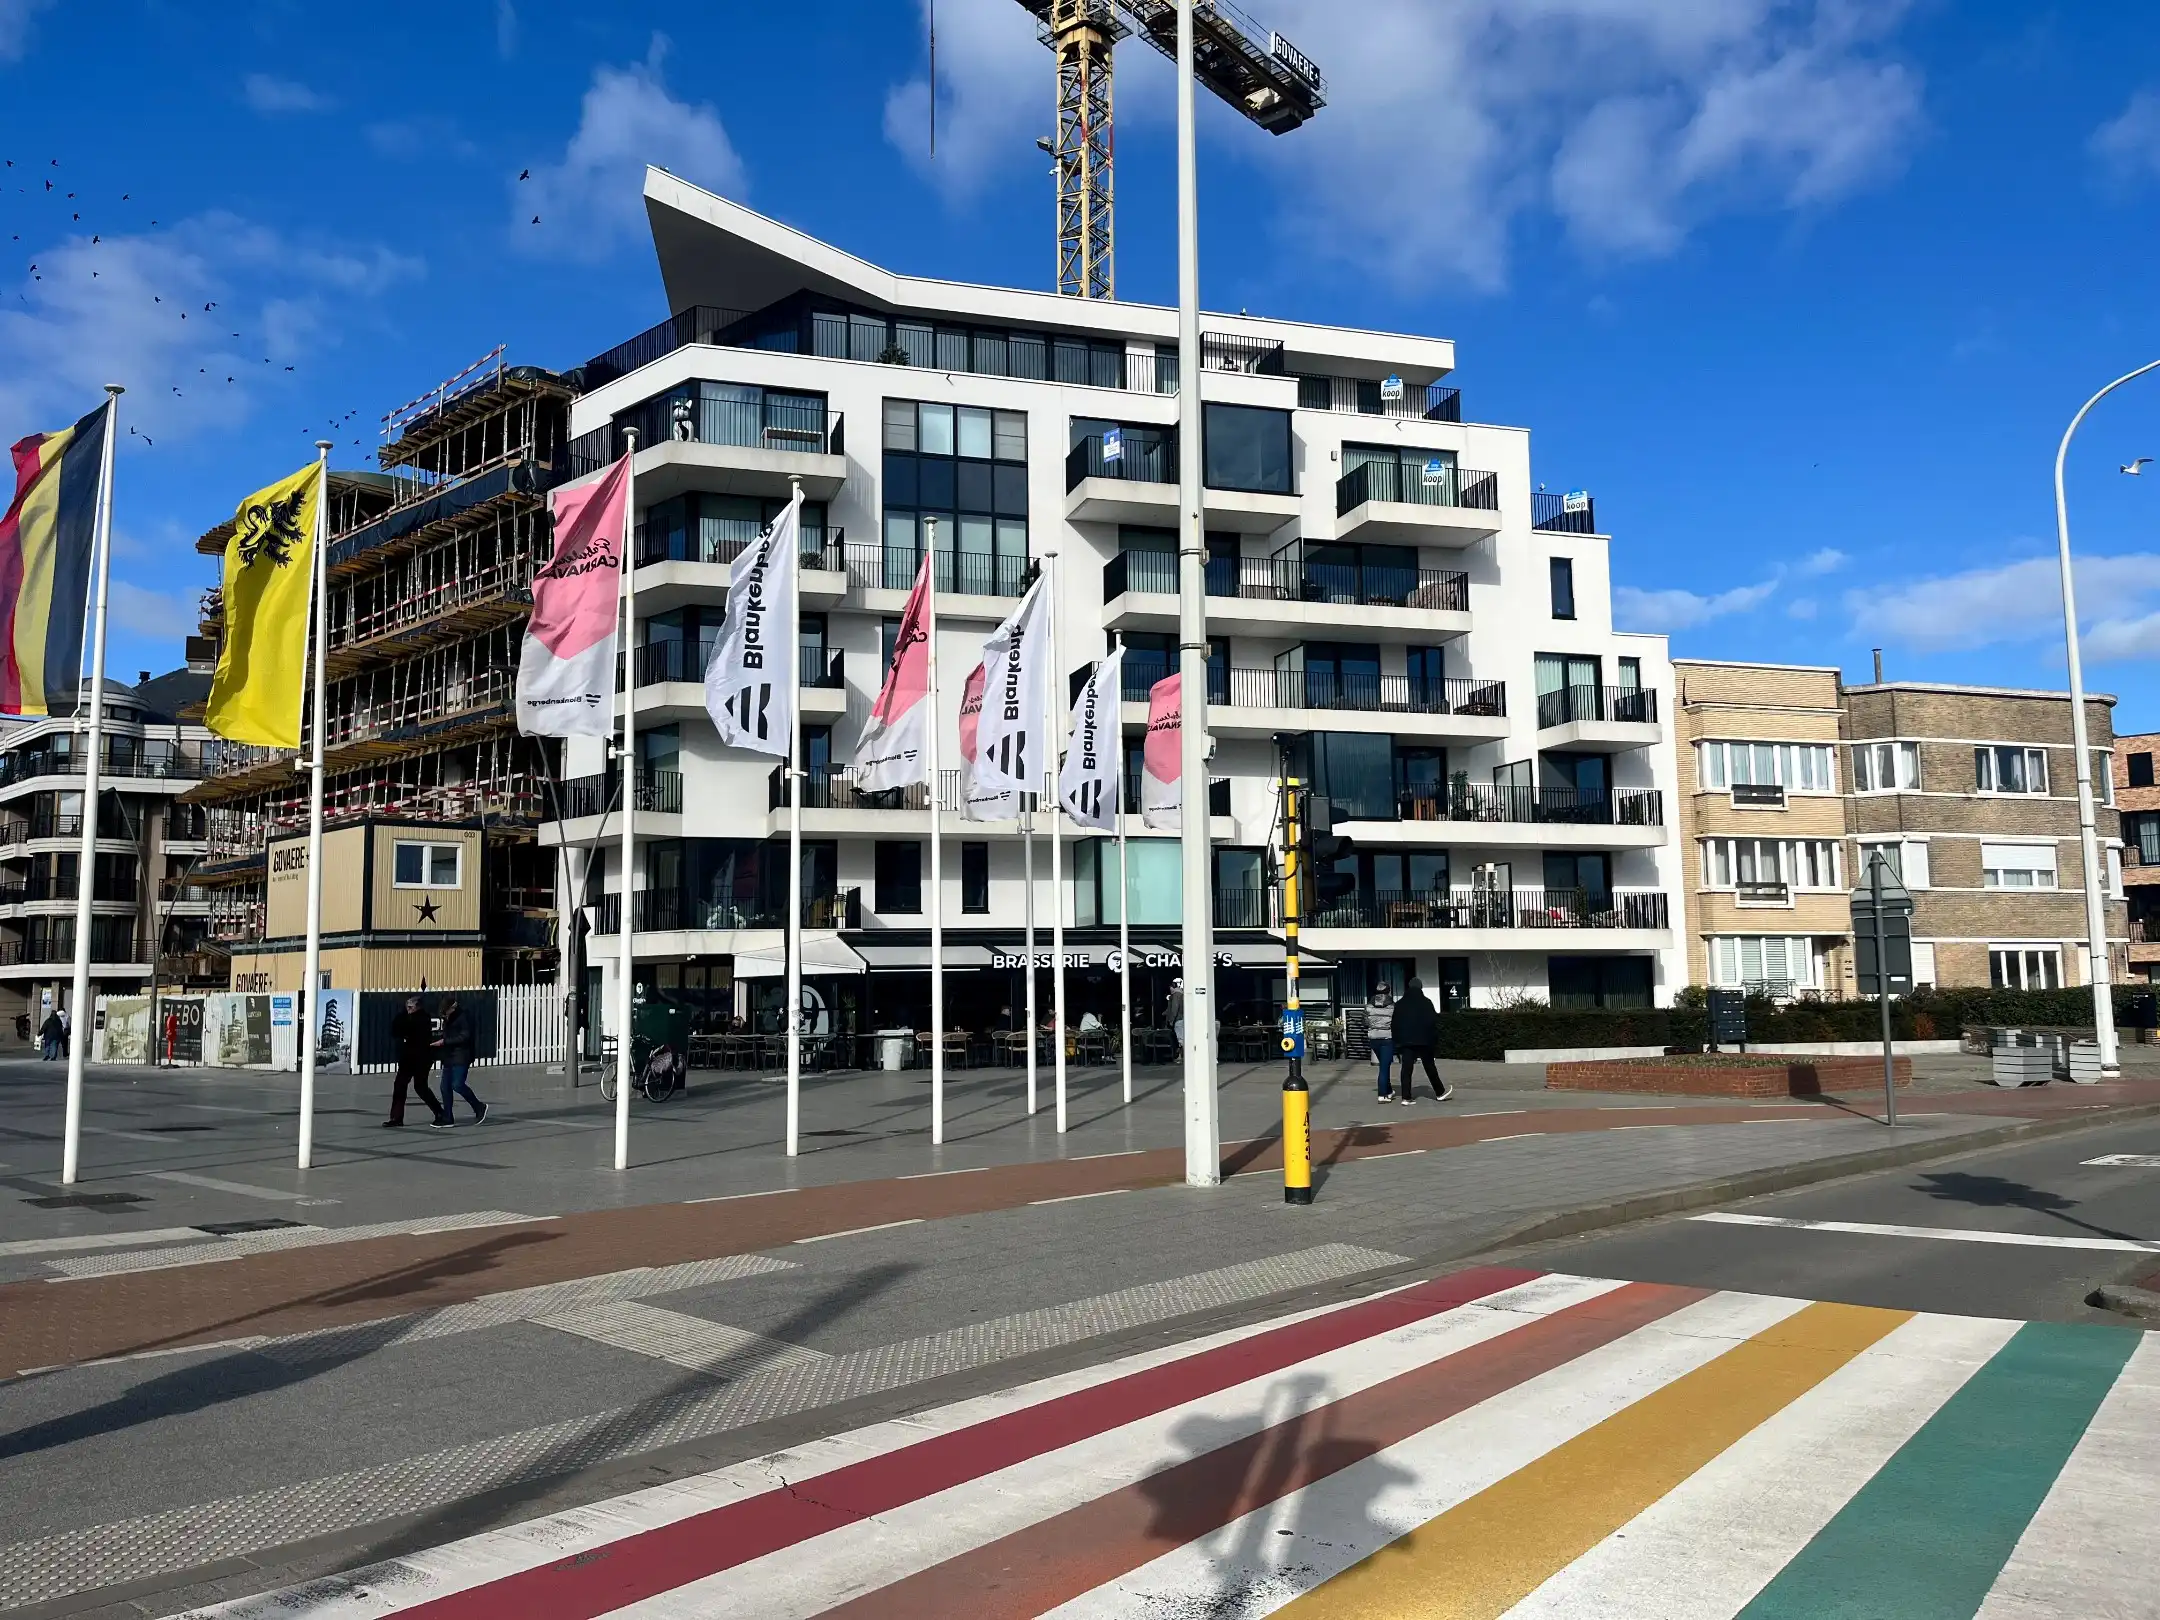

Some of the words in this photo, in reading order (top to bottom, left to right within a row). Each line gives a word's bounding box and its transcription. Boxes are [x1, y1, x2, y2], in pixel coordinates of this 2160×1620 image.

[1275, 36, 1314, 82] GOVAERE
[1382, 388, 1400, 398] koop
[1423, 473, 1443, 483] koop
[1566, 501, 1586, 511] koop
[273, 846, 306, 873] GOVAERE
[1145, 952, 1233, 968] CHAE'S
[1449, 985, 1458, 996] 4
